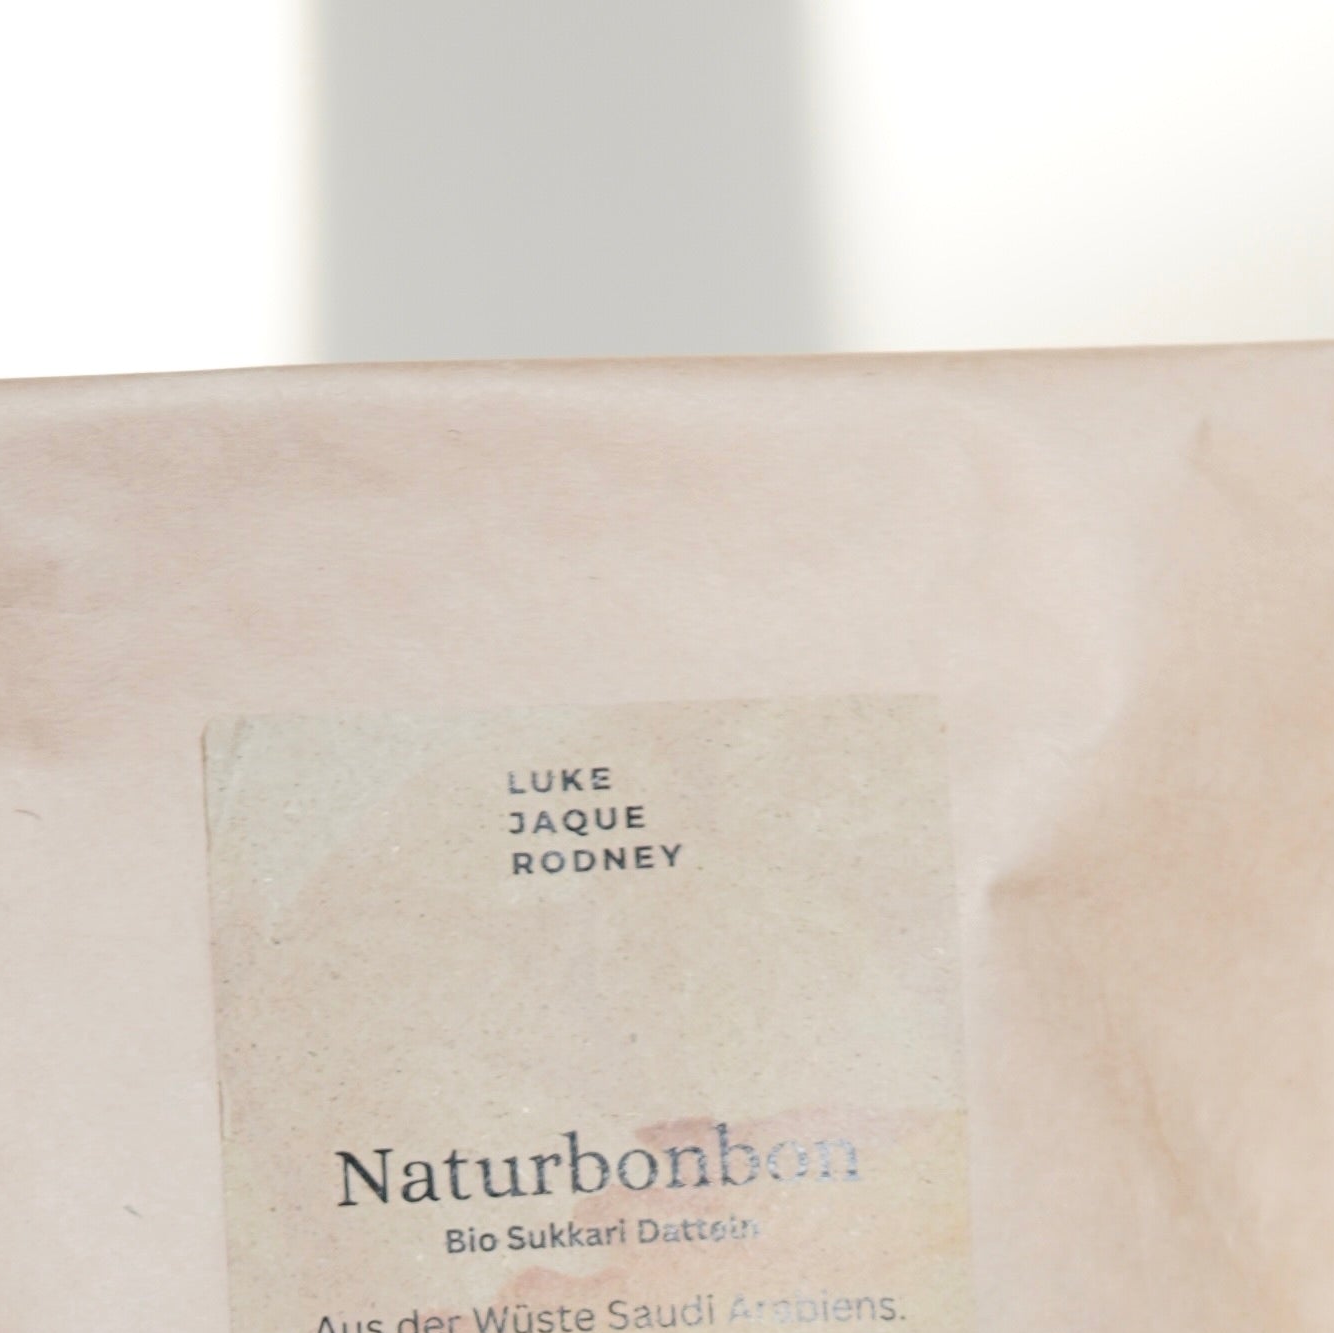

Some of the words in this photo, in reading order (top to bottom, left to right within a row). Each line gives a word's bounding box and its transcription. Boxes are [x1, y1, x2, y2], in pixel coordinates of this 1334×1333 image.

[508, 767, 611, 794] LUKE
[509, 805, 645, 836] JAQUE
[512, 844, 682, 875] RODNEY
[334, 1122, 861, 1207] Naturbonbon
[445, 1227, 497, 1254] Bio
[507, 1218, 626, 1250] Sukkari
[608, 1294, 714, 1330] Saudi
